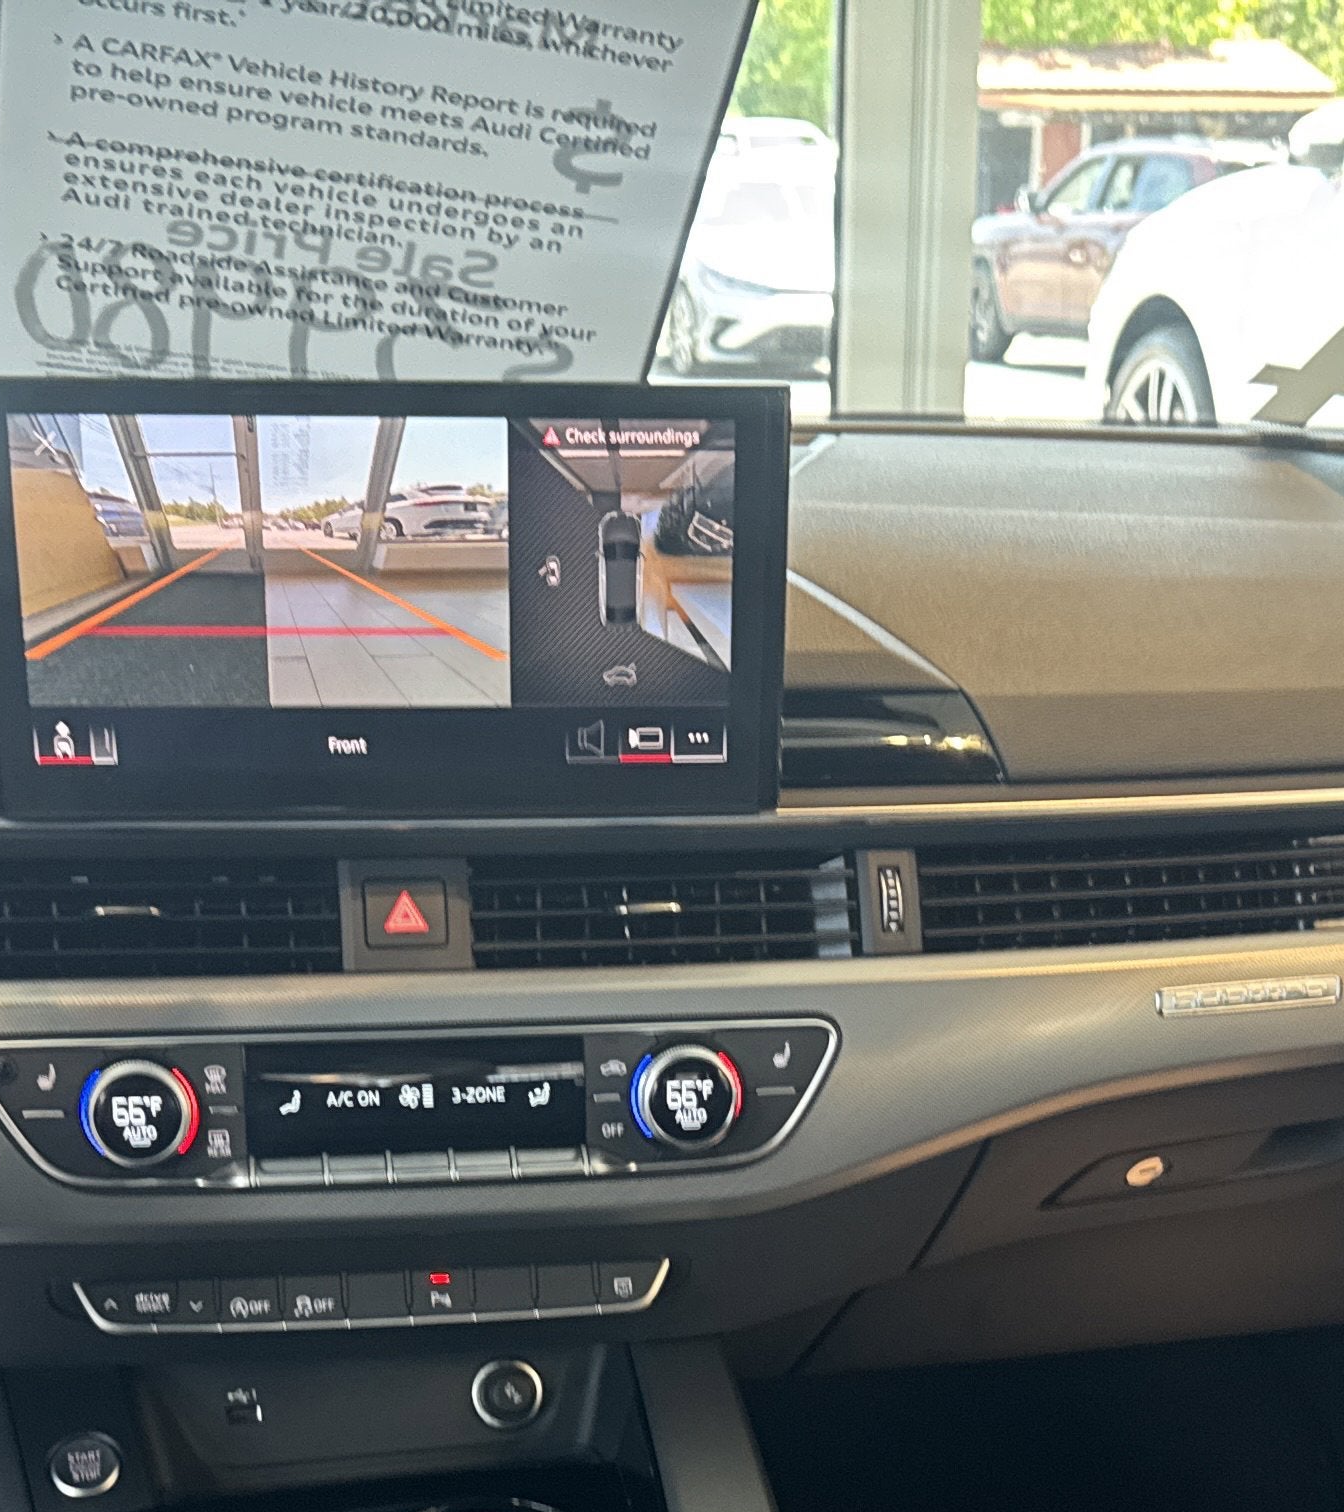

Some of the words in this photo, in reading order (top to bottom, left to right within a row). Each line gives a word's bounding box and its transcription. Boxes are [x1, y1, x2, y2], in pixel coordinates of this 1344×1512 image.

[540, 35, 673, 73] whichever
[557, 10, 684, 52] Warranty
[71, 58, 102, 78] to
[110, 62, 172, 89] help
[180, 74, 272, 101] ensure
[280, 83, 373, 116] vehicle
[381, 101, 464, 130] meets
[471, 115, 532, 142] Audi
[539, 126, 652, 161] Certified
[72, 33, 94, 52] A
[227, 53, 323, 85] Vehicle
[329, 69, 424, 102] History
[431, 84, 520, 116] Report
[525, 99, 545, 120] is
[552, 107, 657, 139] required
[70, 82, 219, 118] pre-owned
[227, 104, 343, 136] program
[351, 119, 489, 158] standards.
[64, 150, 184, 182] ensures
[195, 169, 263, 193] each
[273, 180, 379, 208] vehicle
[388, 197, 541, 231] undergoes
[551, 217, 584, 240] an
[66, 131, 87, 150] A
[95, 138, 307, 178] comprehensive
[313, 167, 476, 203] certification
[485, 192, 585, 219] process
[61, 186, 131, 211] Audi
[143, 197, 250, 227] trained
[261, 213, 403, 249] technician.
[63, 170, 209, 203] extensive
[220, 189, 313, 215] dealer
[325, 202, 476, 242] inspection
[487, 227, 520, 250] by
[529, 237, 563, 255] an
[55, 273, 170, 305] Certified
[178, 292, 315, 323] pre-owned
[322, 308, 418, 338] Limited
[56, 253, 162, 284] Support
[169, 270, 287, 300] available
[294, 285, 334, 305] for
[341, 291, 385, 313] the
[391, 298, 500, 329] duration
[506, 313, 535, 333] of
[540, 321, 597, 344] your
[59, 231, 124, 256] 24/7
[131, 241, 248, 272] Roadside
[254, 258, 388, 295] Assistance
[394, 279, 441, 300] and
[447, 286, 569, 318] Customer
[565, 426, 606, 445] Check
[609, 427, 700, 448] surroundings
[327, 735, 368, 755] Front
[326, 1090, 354, 1108] A/C
[357, 1089, 381, 1108] ON
[452, 1086, 506, 1105] 3-ZONE
[601, 1122, 625, 1139] OFF
[249, 1299, 271, 1316] OFF
[313, 1297, 335, 1314] OFF
